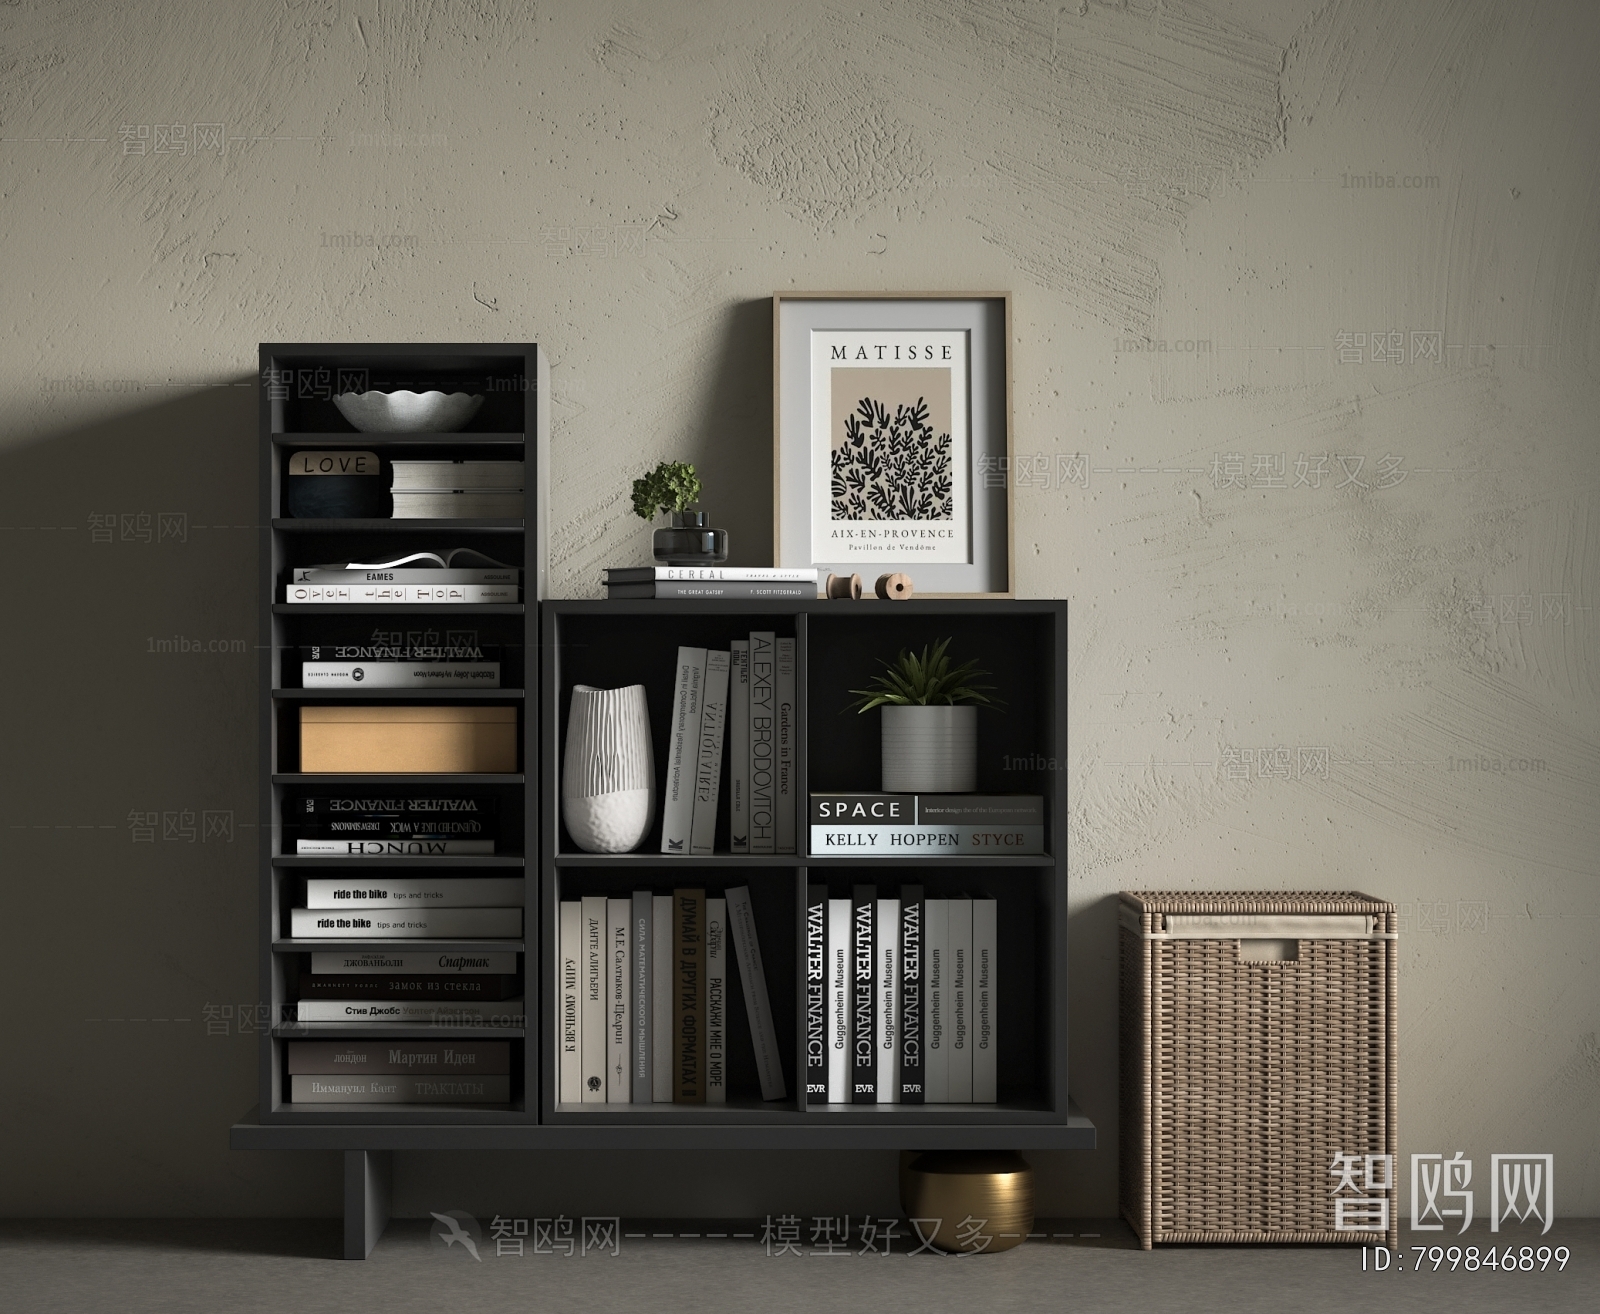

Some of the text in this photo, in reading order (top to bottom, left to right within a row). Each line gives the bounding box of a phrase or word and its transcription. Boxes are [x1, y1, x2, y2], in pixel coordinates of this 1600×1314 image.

[831, 345, 952, 360] MATISSE
[304, 456, 367, 473] LOVE
[831, 530, 954, 539] AIX-EN-PROVENCE
[366, 573, 394, 581] EAMES
[668, 570, 725, 580] CEREAL
[294, 588, 463, 600] Over the Top
[335, 646, 484, 658] WALTER FINANCE
[454, 670, 469, 679] Jolley
[754, 637, 772, 711] ALEXEY
[780, 702, 791, 795] Gardens in France
[754, 718, 772, 839] BRODOVITCH
[330, 800, 478, 811] WALTER FINANCE
[819, 802, 900, 818] SPACE
[361, 822, 380, 831] DREW
[390, 822, 412, 833] WICK
[413, 822, 420, 832] A
[421, 822, 437, 833] LIKE
[347, 842, 447, 854] MUNCH
[826, 834, 1025, 846] KELLY HOPPEN STYCE
[334, 890, 351, 900] ride
[352, 890, 367, 900] the
[368, 890, 388, 900] bike
[394, 892, 407, 900] tips
[317, 919, 428, 930] ride the bike tips and tricks
[343, 960, 404, 969] ДЖОВАНЬОЛИ
[439, 955, 490, 971] Спартак
[589, 918, 599, 1001] ДАНТЕ АЛИГЬЕРИ
[612, 926, 626, 1045] М.Е. Салтыков-Щедрин
[680, 897, 701, 1085] ДУМАЙ В ДРУГИХ ФОРМАТАХ
[808, 903, 823, 1067] WALTER FINANCE
[856, 903, 872, 1067] WALTER FINANCE
[904, 903, 919, 1067] WALTER FINANCE
[566, 958, 576, 1053] К ВЕЧНОМУ МИРУ
[638, 918, 646, 1078] СИЛА МАТЕМАТИЧЕСКОГО МЫШЛЕНИЯ
[710, 978, 722, 1029] РАССКАЖИ
[835, 948, 846, 1050] Guggenheim Museum
[884, 948, 895, 1050] Guggenheim Museum
[931, 948, 942, 1050] Guggenheim Museum
[955, 948, 966, 1050] Guggenheim Museum
[980, 948, 991, 1050] Guggenheim Museum
[345, 1006, 368, 1015] Стив
[370, 1006, 401, 1017] Джобс
[710, 1032, 722, 1050] МНЕ
[389, 1050, 476, 1067] Мартин Иден
[710, 1062, 722, 1087] МОРЕ
[312, 1082, 484, 1096] Иммануил Кант ТРАКТАТЫ
[807, 1084, 826, 1093] EVR
[855, 1084, 874, 1093] EVR
[903, 1084, 922, 1093] EVR
